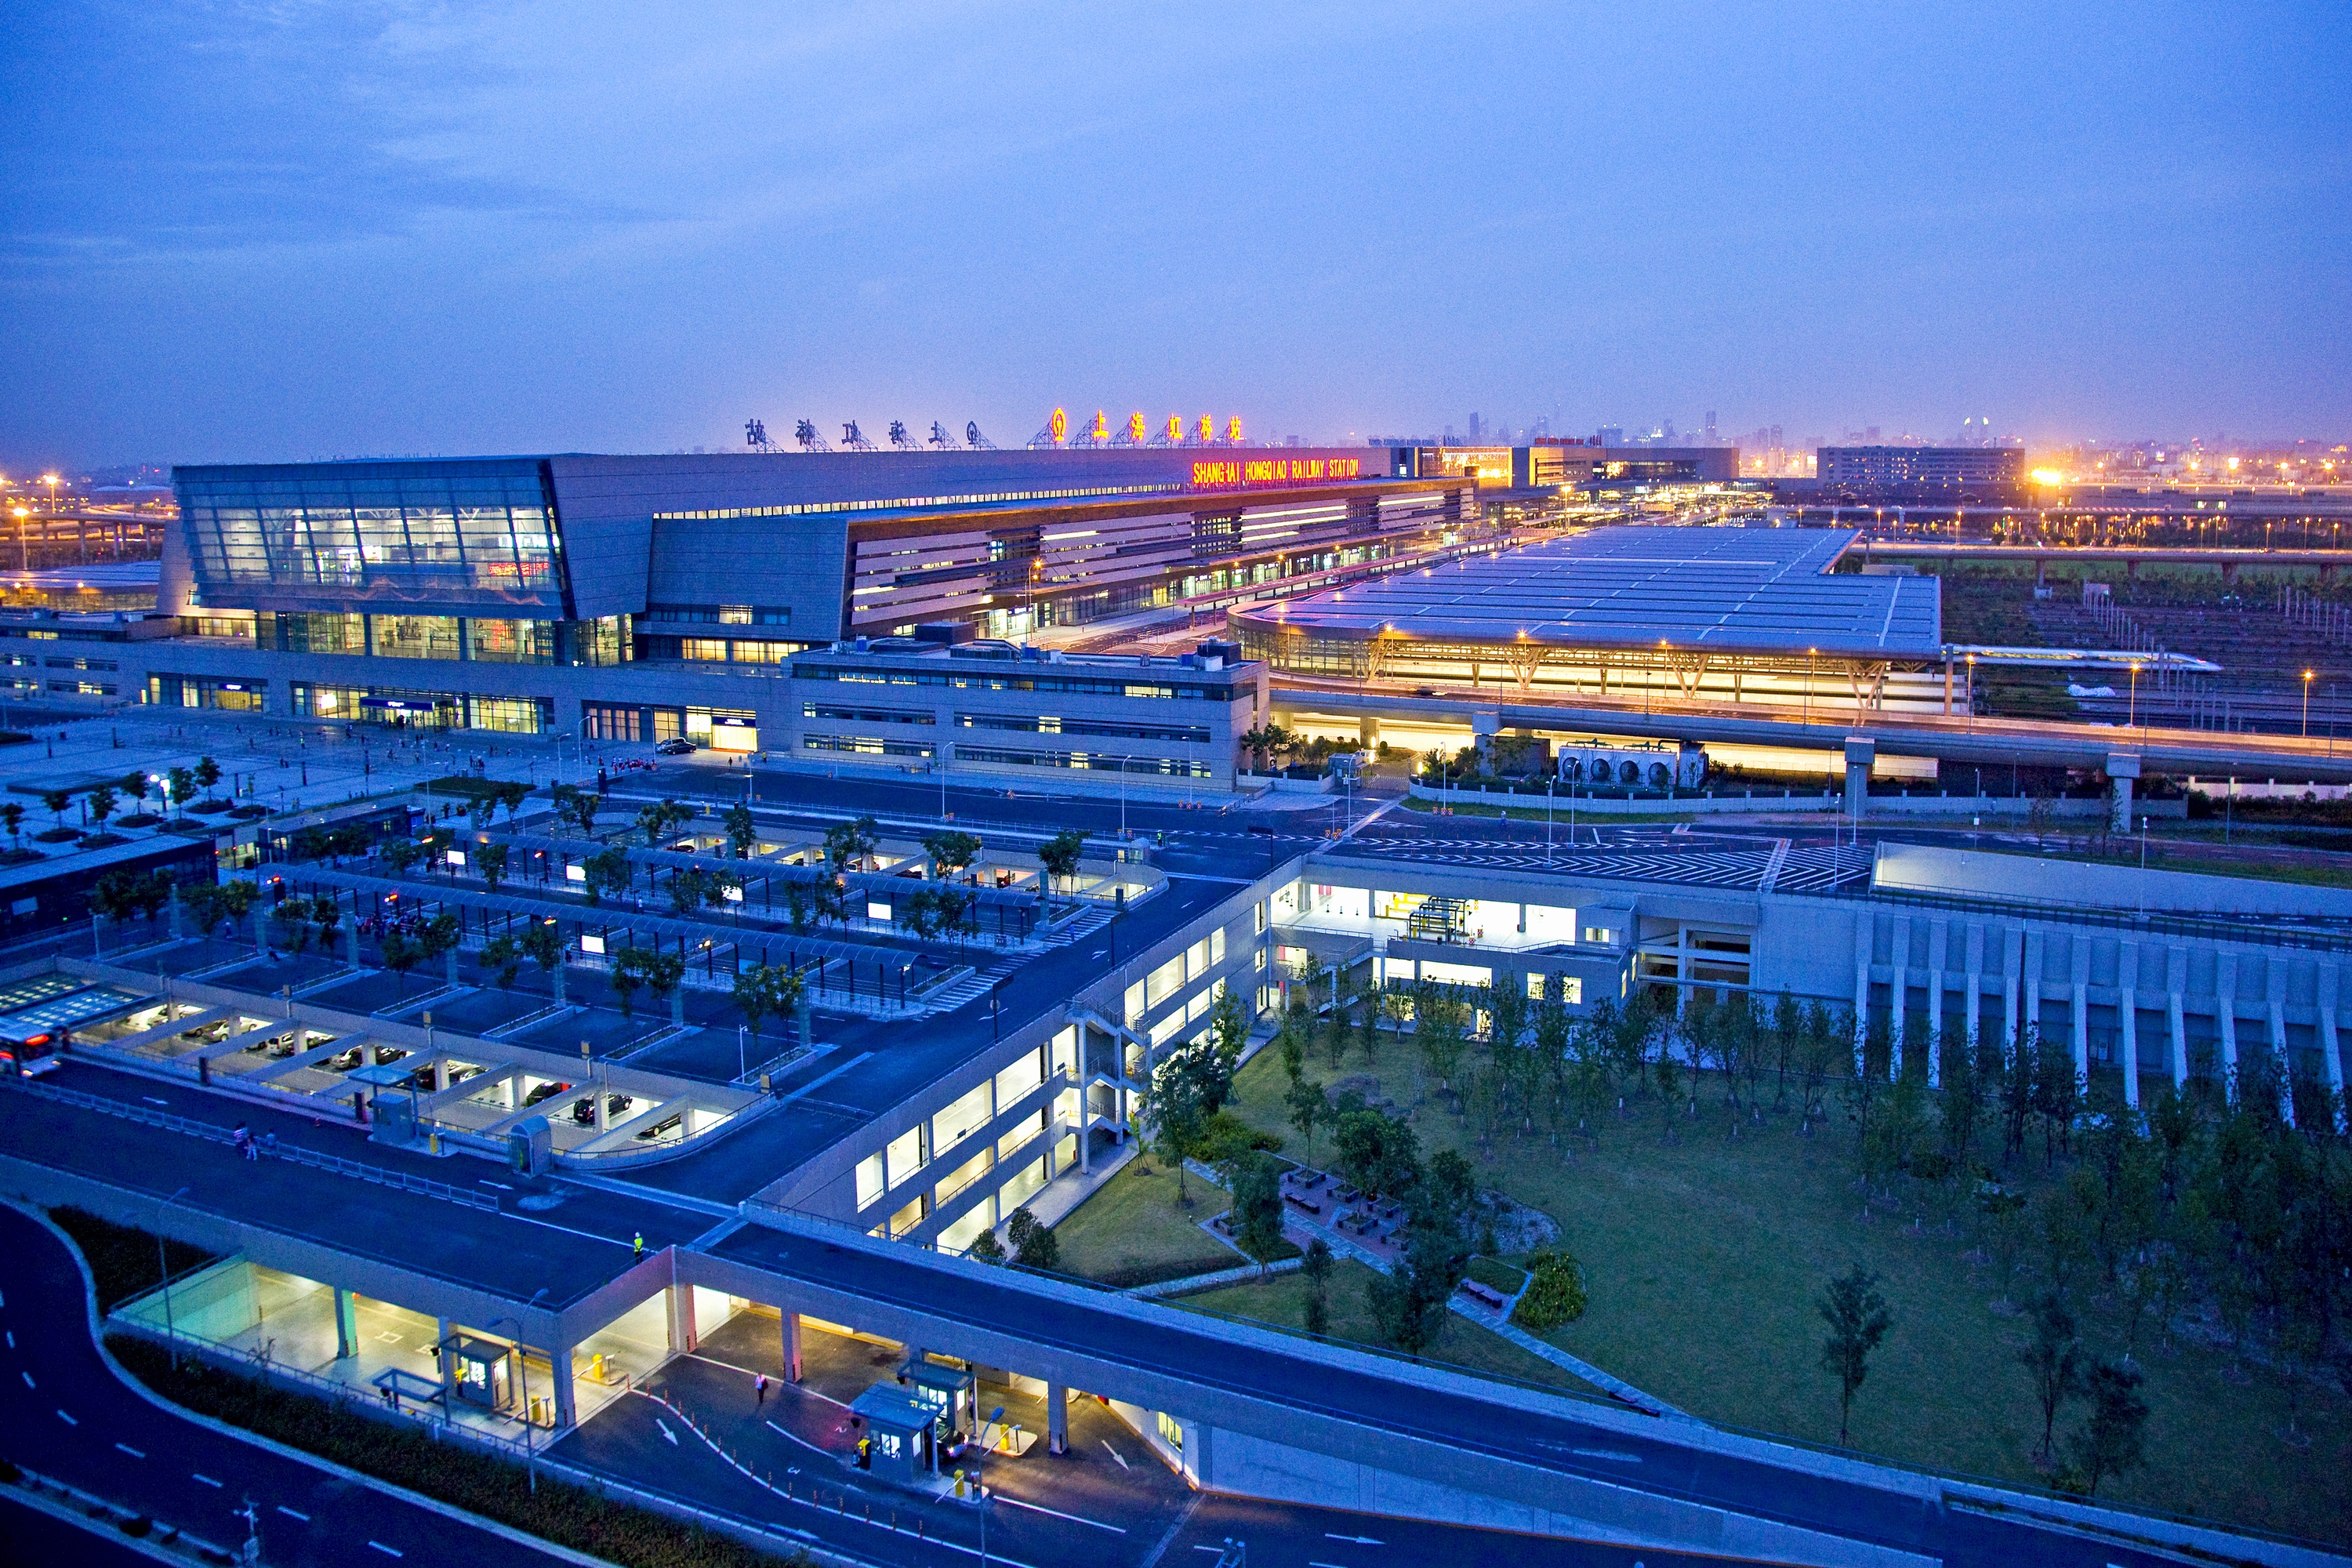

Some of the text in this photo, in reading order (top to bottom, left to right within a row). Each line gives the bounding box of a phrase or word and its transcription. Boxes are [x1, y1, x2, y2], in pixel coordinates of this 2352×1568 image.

[1093, 410, 1242, 441] 上海虹桥站
[1193, 458, 1359, 484] SHANGHAI HONGQIAO RAILWAY STATION
